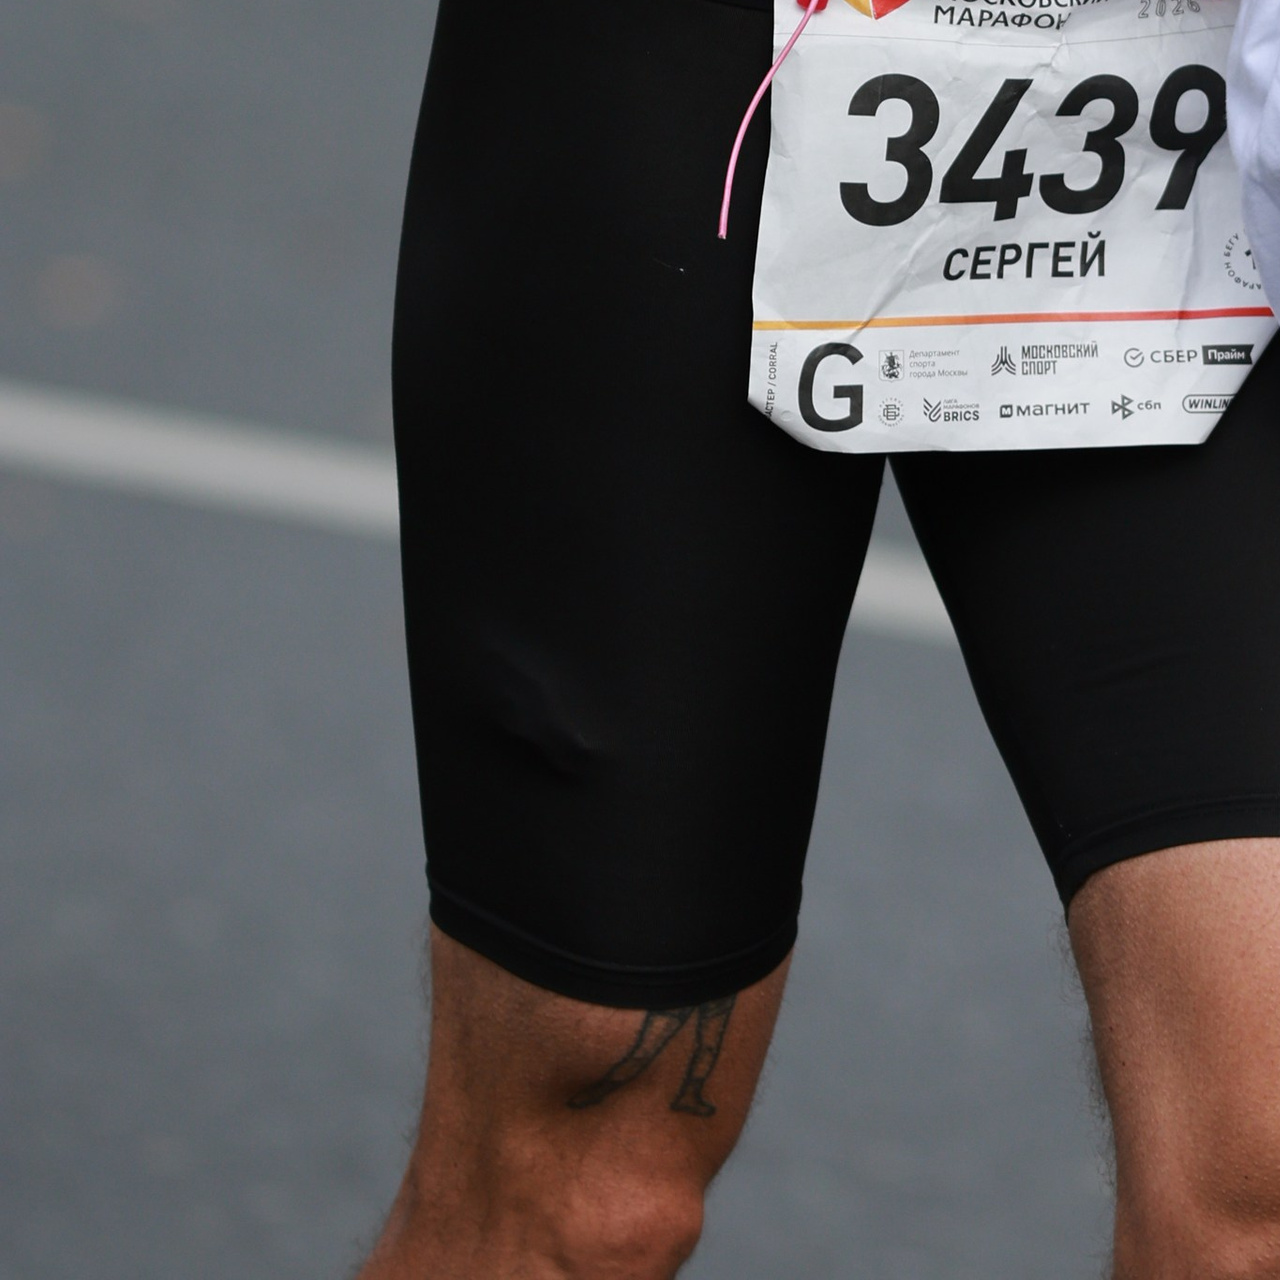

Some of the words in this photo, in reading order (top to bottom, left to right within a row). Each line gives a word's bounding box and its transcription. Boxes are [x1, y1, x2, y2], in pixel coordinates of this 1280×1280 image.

[839, 64, 1227, 227] 3439
[942, 230, 1106, 281] СЕРГЕЙ
[1224, 261, 1262, 290] АРАФОН
[908, 350, 960, 359] Департамент
[1021, 340, 1098, 359] МОСКОВСКИЙ
[1150, 349, 1198, 364] СБЕР
[1207, 348, 1246, 361] Прайм
[768, 342, 778, 380] CORRAL
[909, 361, 936, 369] спорта
[1021, 360, 1057, 376] СПОРТ
[937, 369, 968, 377] Москвы
[798, 342, 864, 433] G
[764, 388, 776, 418] АСТЕР
[1188, 398, 1230, 409] WINLIN
[943, 410, 980, 422] BRICS
